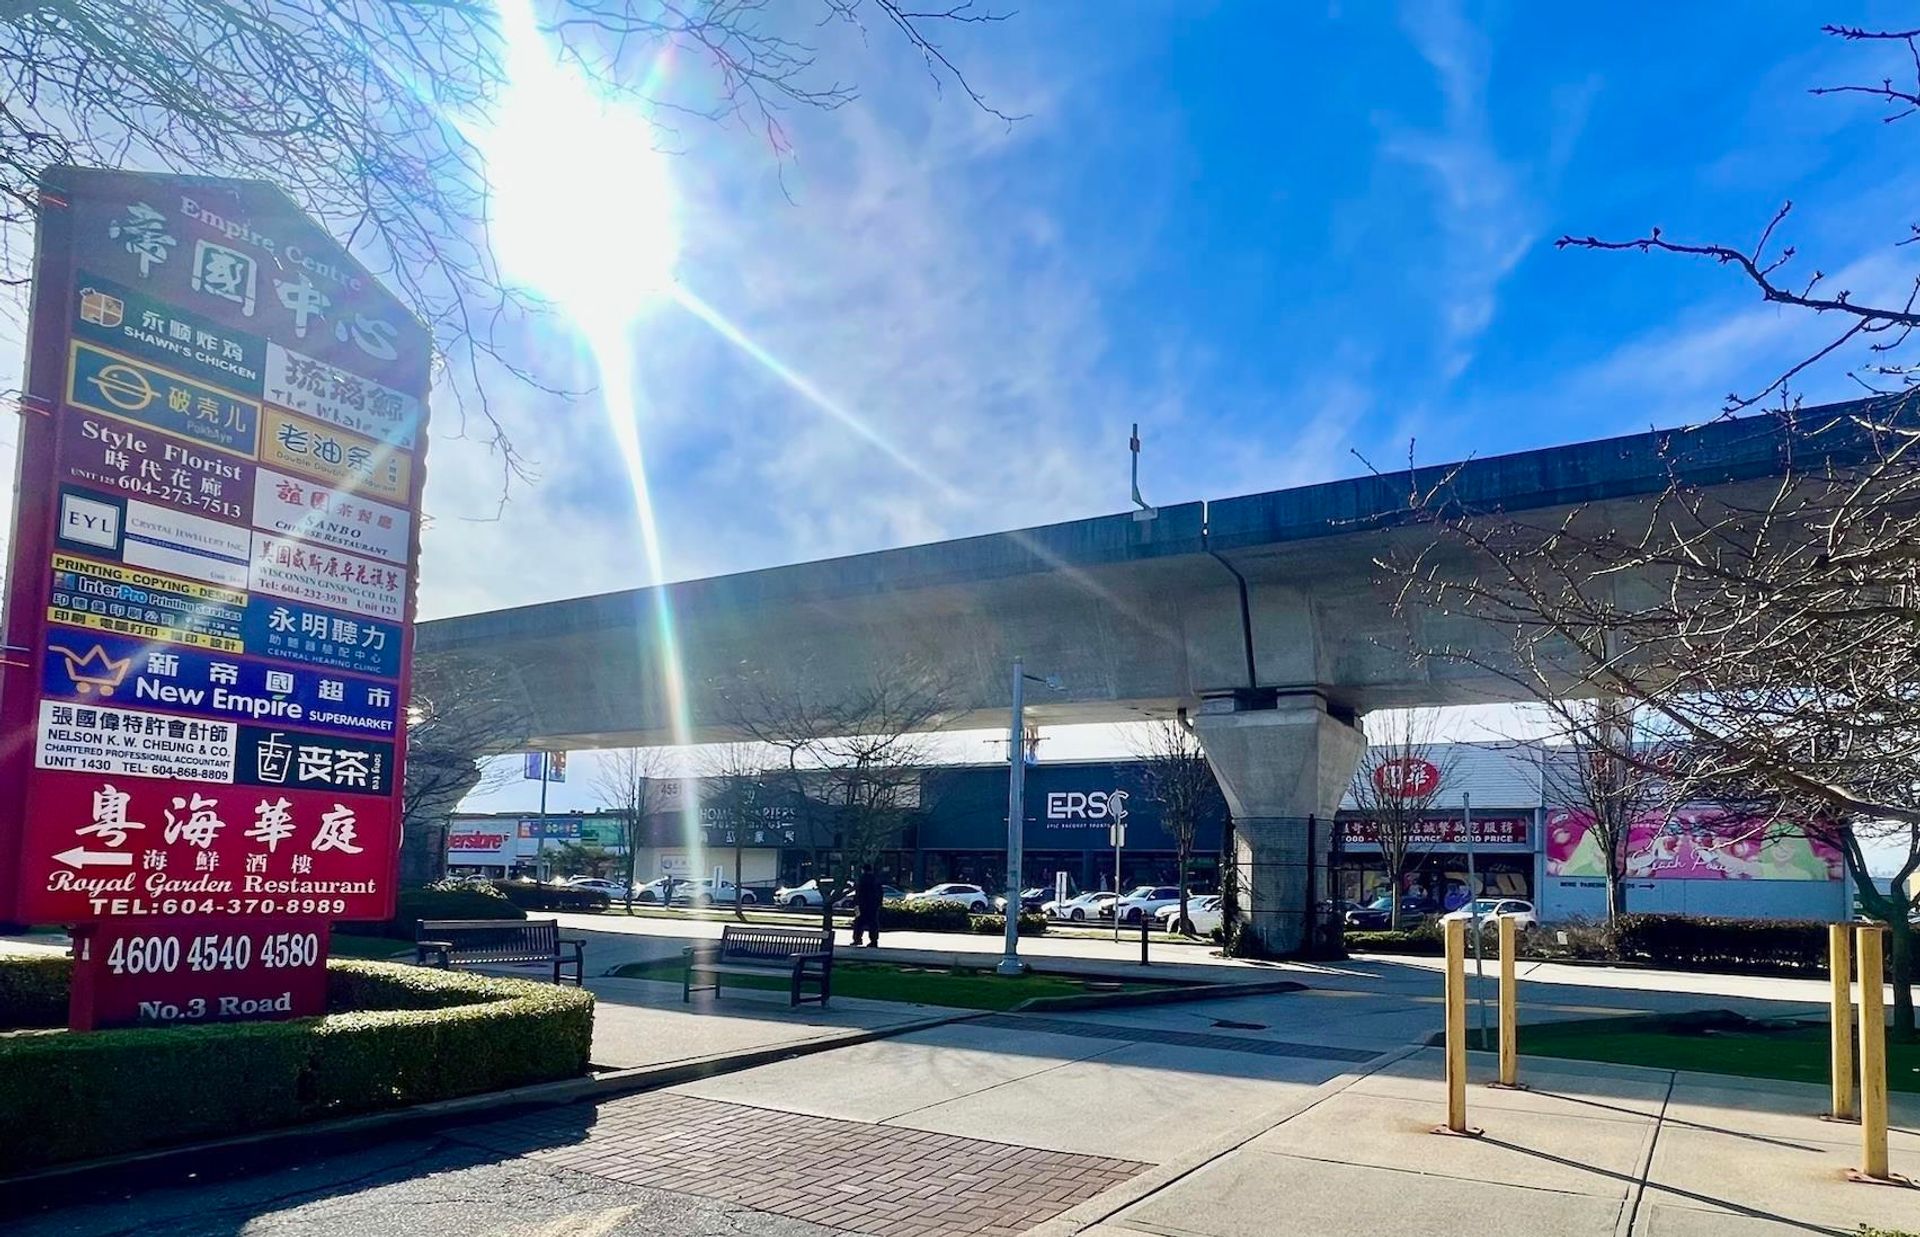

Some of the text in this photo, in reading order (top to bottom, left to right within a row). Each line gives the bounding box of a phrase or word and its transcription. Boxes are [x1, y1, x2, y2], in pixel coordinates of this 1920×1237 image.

[180, 197, 362, 292] Empire Centre
[109, 202, 398, 361] 帝國中心
[123, 325, 256, 380] SHAWN'S CHICKEN
[168, 385, 247, 432] 破壳儿
[271, 388, 307, 408] The
[381, 427, 410, 447] Ta
[82, 420, 243, 481] Style Florist
[276, 450, 311, 467] Double
[104, 449, 223, 498] 時代花廊
[70, 467, 96, 481] UNIT
[118, 474, 241, 519] 604-273-7513
[69, 511, 112, 533] EYL
[275, 520, 389, 556] CHISE RESTAURANT
[305, 514, 362, 539] SANBO
[55, 557, 244, 605] PRINTING COPYING DESIGN
[259, 566, 316, 585] WISCONSIN
[317, 578, 361, 596] GINSENG
[78, 576, 149, 603] InterPro
[149, 593, 194, 613] Printing
[193, 601, 242, 622] Services
[357, 598, 378, 612] Unit
[268, 606, 386, 651] 永明聽力
[267, 648, 382, 674] CENTRAL HEARING CLINIC
[148, 652, 392, 708] 新帝國超市
[135, 676, 394, 732] New Empire SUPERMARKET
[44, 742, 231, 768] CHARTERED PROFESSIONAL ACCOUNTANT
[48, 728, 231, 758] NELSON K. W. CHEUNG & CO.
[44, 756, 229, 780] UNIT 1430 TEL: 604-868-8809
[1047, 791, 1129, 819] ERSC
[1484, 835, 1513, 843] PRICE
[142, 849, 313, 875] 海鮮酒樓
[46, 869, 377, 898] Royal Garden Restaurant
[89, 898, 346, 916] TEL:604-370-8989
[107, 932, 319, 974] 4600 4540 4580
[138, 992, 292, 1021] No.3 Road
